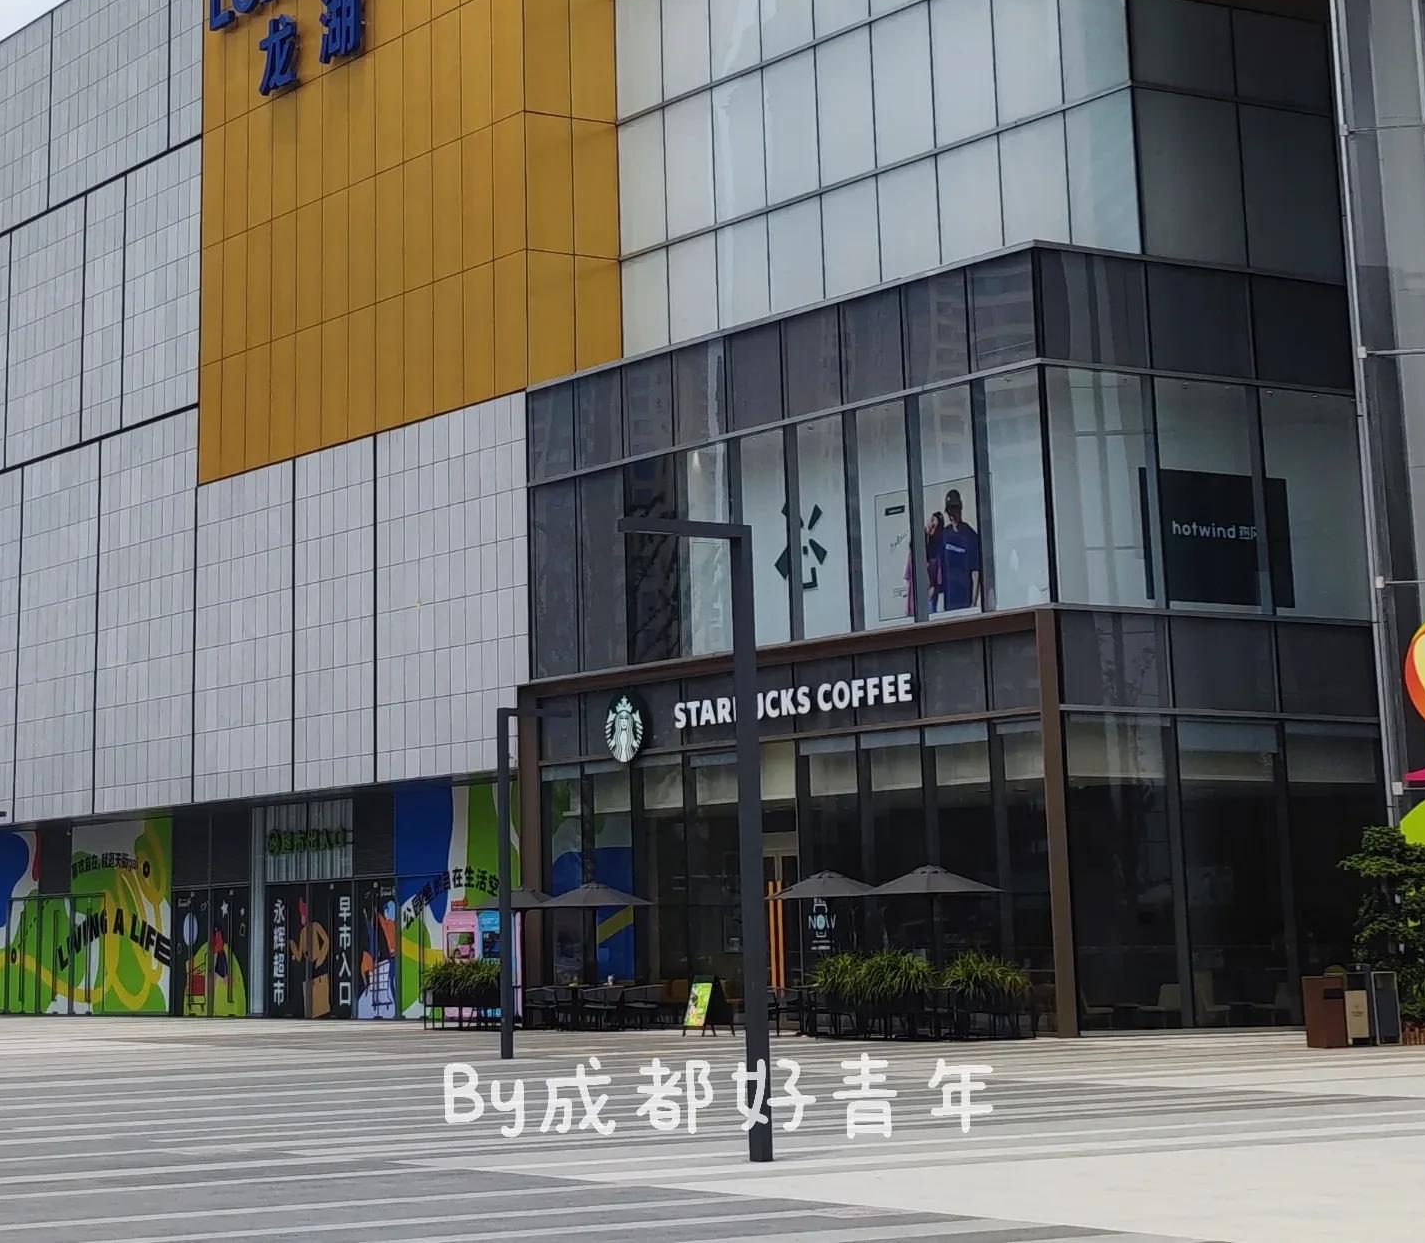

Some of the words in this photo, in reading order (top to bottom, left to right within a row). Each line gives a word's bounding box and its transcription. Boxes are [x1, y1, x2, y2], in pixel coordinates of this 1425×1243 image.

[1172, 520, 1236, 539] hotwind
[816, 672, 913, 713] COFFEE
[113, 908, 124, 935] A
[130, 913, 171, 967] LIFE
[339, 896, 352, 1006] 早市入口
